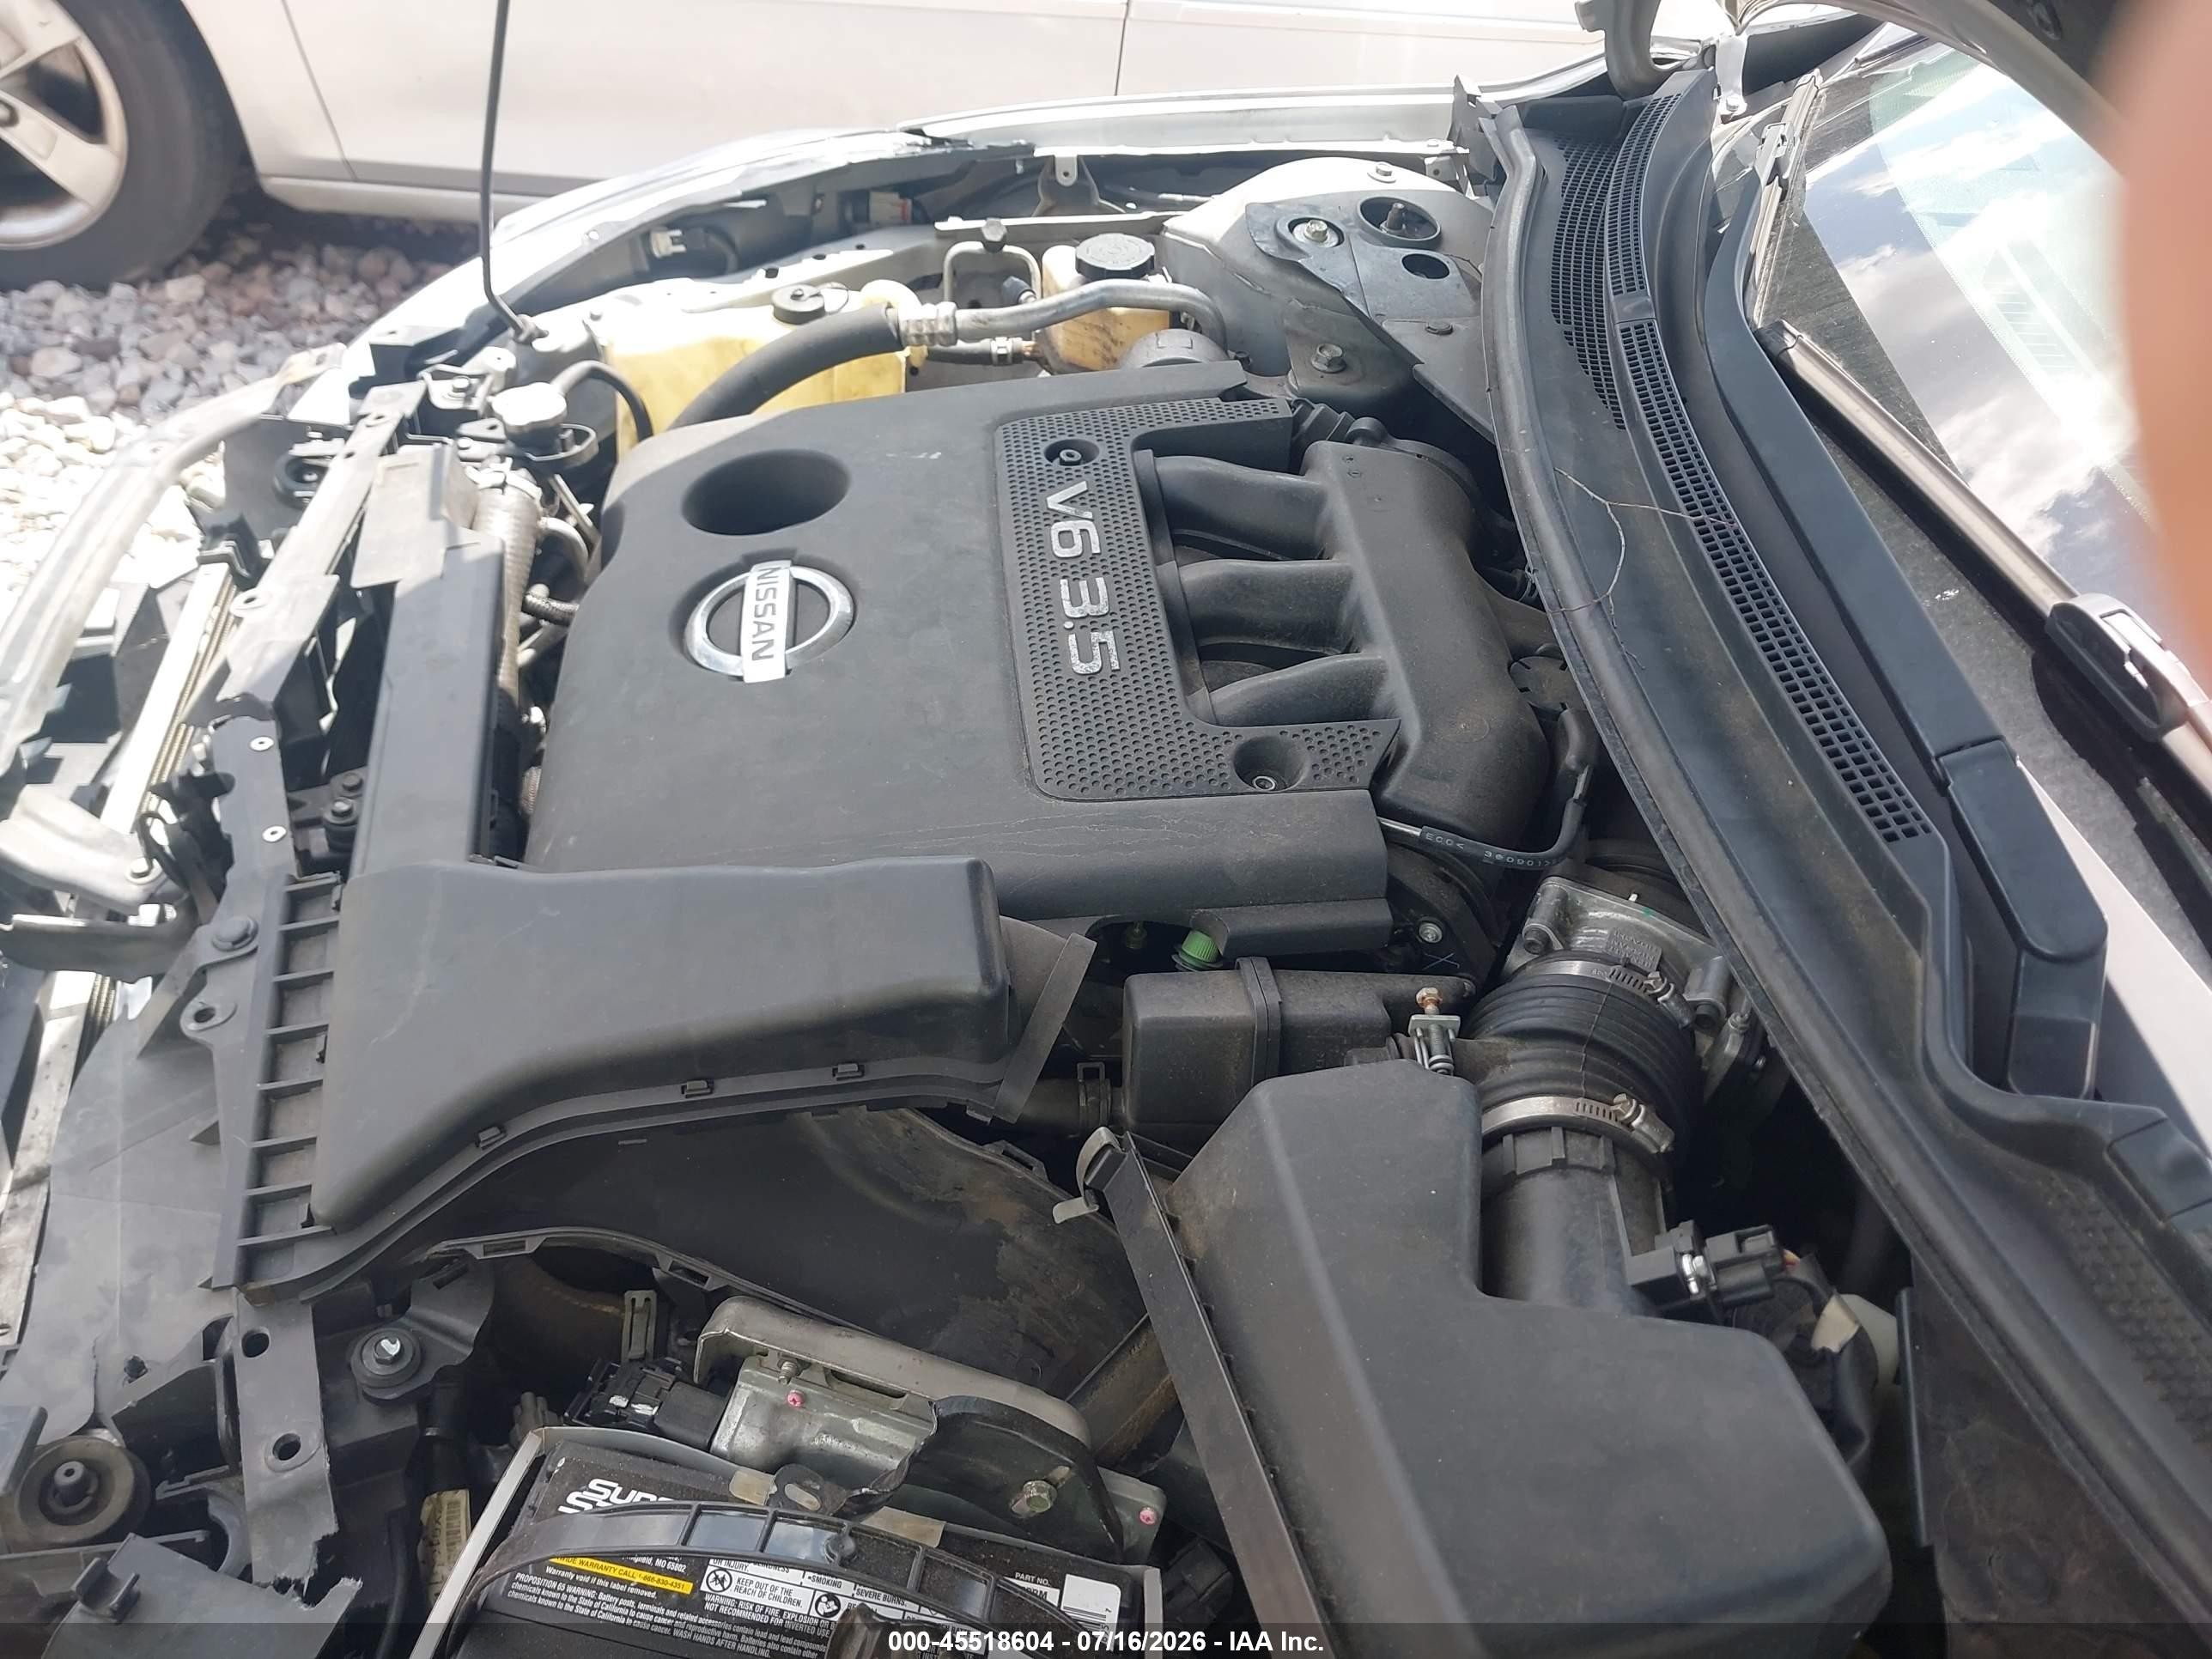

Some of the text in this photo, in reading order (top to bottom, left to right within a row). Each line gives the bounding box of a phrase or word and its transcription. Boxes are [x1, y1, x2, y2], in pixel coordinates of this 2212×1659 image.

[1046, 480, 1121, 675] V6 3.5
[751, 566, 781, 661] NISSAN
[545, 1565, 575, 1581] Warranty
[575, 1575, 592, 1583] void
[597, 1577, 610, 1588] this
[610, 1581, 628, 1592] label
[627, 1586, 658, 1599] removed.
[579, 1559, 617, 1573] WARRANTY
[618, 1570, 636, 1579] CALL
[666, 1561, 687, 1573] 65802
[1015, 1571, 1051, 1586] PART NO.
[733, 1585, 803, 1608] REACH OF CHILDREN.
[736, 1577, 754, 1585] KEEP
[755, 1581, 769, 1590] OUT
[781, 1587, 794, 1596] THE
[855, 1588, 882, 1601] SEVERE
[507, 1589, 538, 1603] chemicals
[537, 1595, 557, 1608] known
[563, 1602, 574, 1612] the
[574, 1605, 591, 1617] State
[590, 1608, 599, 1617] of
[598, 1610, 626, 1624] California
[632, 1620, 651, 1630] cause
[650, 1624, 671, 1635] cancer.
[672, 1628, 693, 1640] WASH
[692, 1632, 716, 1645] HANDS
[715, 1638, 738, 1650] AFTER
[737, 1642, 771, 1658] HANDLING.
[511, 1582, 542, 1595] chemicals
[541, 1588, 561, 1600] known
[561, 1592, 568, 1601] to
[567, 1594, 577, 1603] the
[578, 1597, 594, 1607] State
[601, 1601, 629, 1615] California
[629, 1608, 635, 1617] to
[635, 1612, 653, 1621] cause
[653, 1615, 674, 1626] cancer
[674, 1620, 686, 1629] and
[686, 1623, 722, 1638] reproductive
[721, 1631, 739, 1642] harm.
[740, 1634, 767, 1648] Batteries
[767, 1641, 780, 1650] also
[780, 1644, 802, 1656] contain
[802, 1650, 818, 1659] other
[515, 1572, 827, 1652] PROPOSITION 65 WARNING: Battery posts, terminals and related accessories contain lead and lead compounds
[704, 1594, 738, 1608] WARNING:
[738, 1601, 755, 1611] RISK
[755, 1605, 764, 1613] OF
[782, 1611, 819, 1626] EXPLOSION
[819, 1620, 830, 1629] OR
[704, 1601, 719, 1613] NOT
[719, 1604, 769, 1623] RECOMMENDED
[769, 1617, 784, 1627] FOR
[784, 1620, 817, 1635] INVERTED
